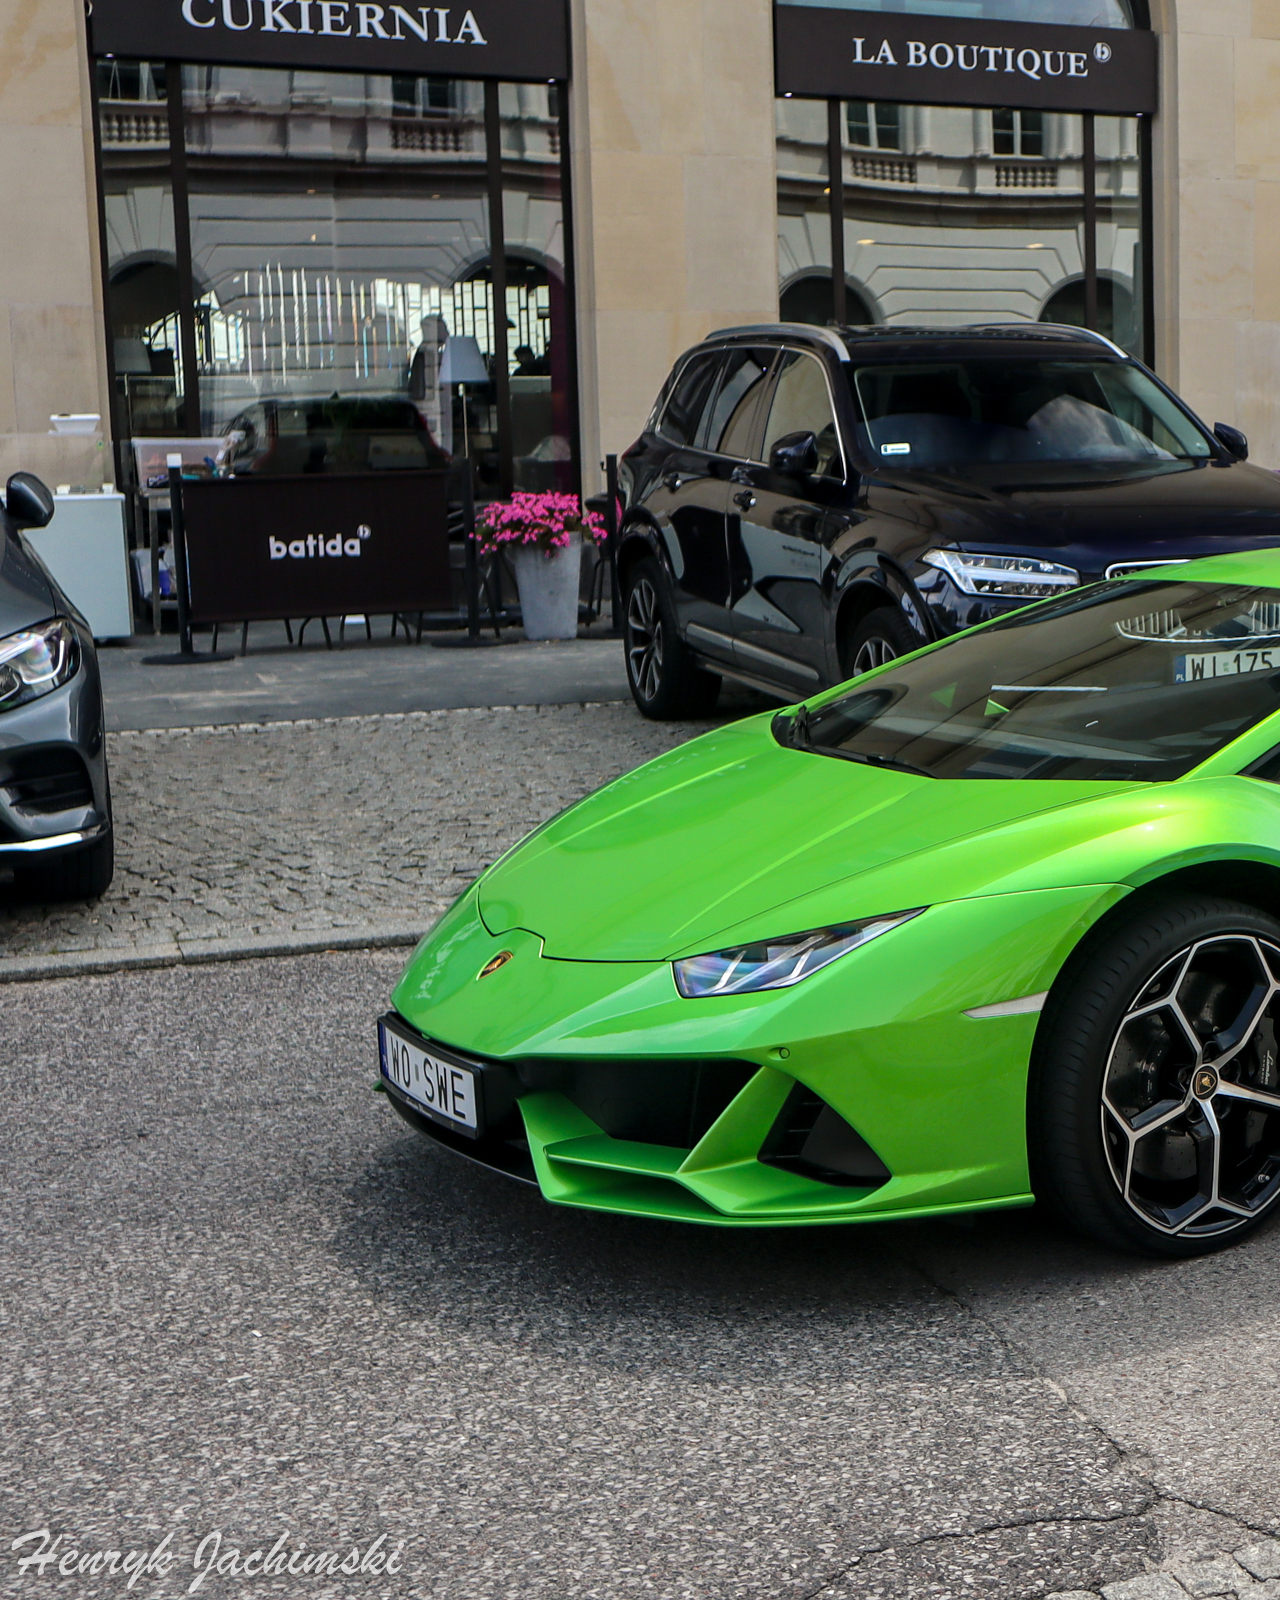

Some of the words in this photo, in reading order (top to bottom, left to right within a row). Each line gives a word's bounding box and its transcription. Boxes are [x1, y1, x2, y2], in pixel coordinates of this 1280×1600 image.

[181, 0, 488, 45] CUKIERNIA
[852, 37, 898, 65] LA
[906, 41, 1089, 80] BOUTIQUE
[269, 533, 361, 560] batida
[390, 1035, 411, 1089] WO
[423, 1057, 466, 1120] SWE
